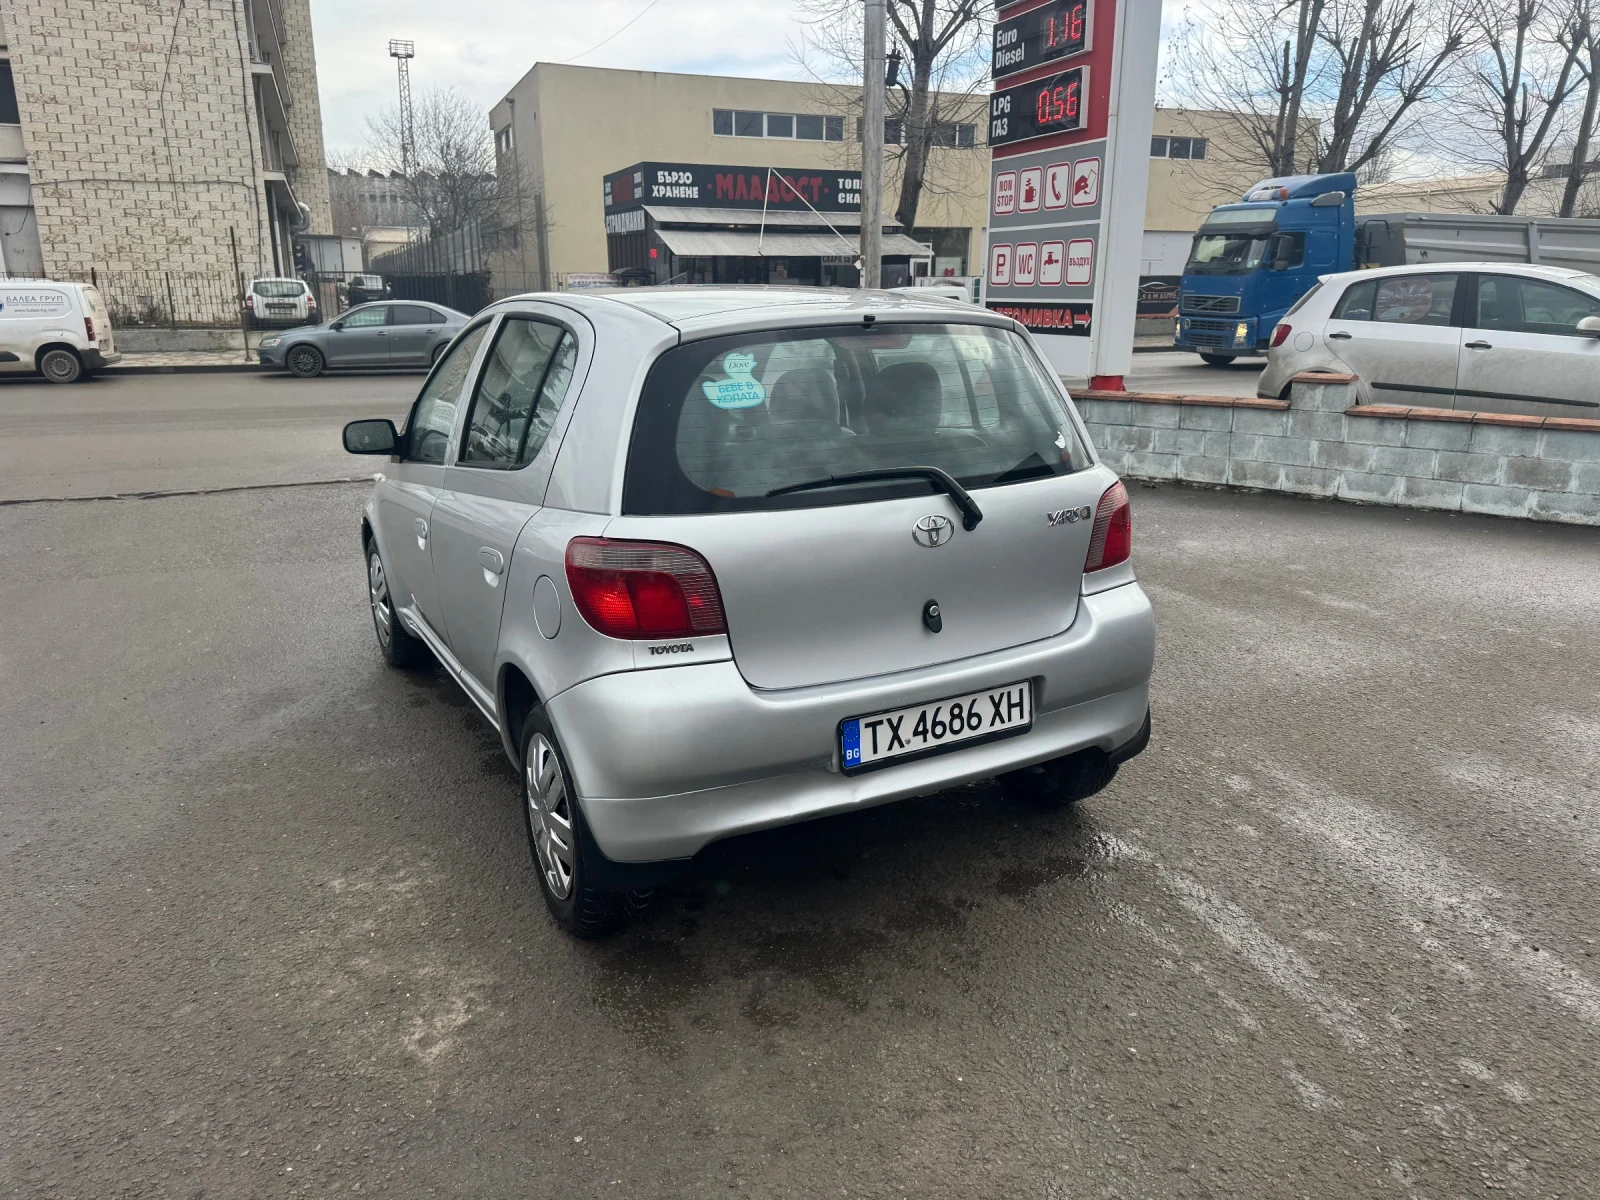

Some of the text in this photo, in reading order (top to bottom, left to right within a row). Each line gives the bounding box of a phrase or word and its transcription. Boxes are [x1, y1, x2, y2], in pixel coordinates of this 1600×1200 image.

[1049, 4, 1083, 47] 1.16
[996, 28, 1018, 48] Euro
[995, 42, 1025, 69] Diesel
[992, 95, 1011, 116] LPG
[1038, 82, 1078, 123] 0.56
[992, 117, 1008, 138] ГАЗ
[657, 170, 693, 184] БЪРЗО
[837, 178, 863, 190] ТОП
[652, 185, 699, 199] ХРАНЕНЕ
[715, 173, 823, 203] МЛАДОСТ
[999, 180, 1013, 192] NON
[997, 195, 1013, 207] STOP
[1019, 254, 1033, 275] WC
[1068, 256, 1090, 268] ВЪЗДУХ
[1159, 292, 1177, 300] AUTO
[728, 361, 750, 370] Dove
[718, 381, 754, 393] БЕБЕ В
[717, 391, 760, 404] КОЛАТА
[648, 642, 695, 656] TOYOTA
[912, 698, 983, 743] 4686
[846, 748, 860, 760] BG
